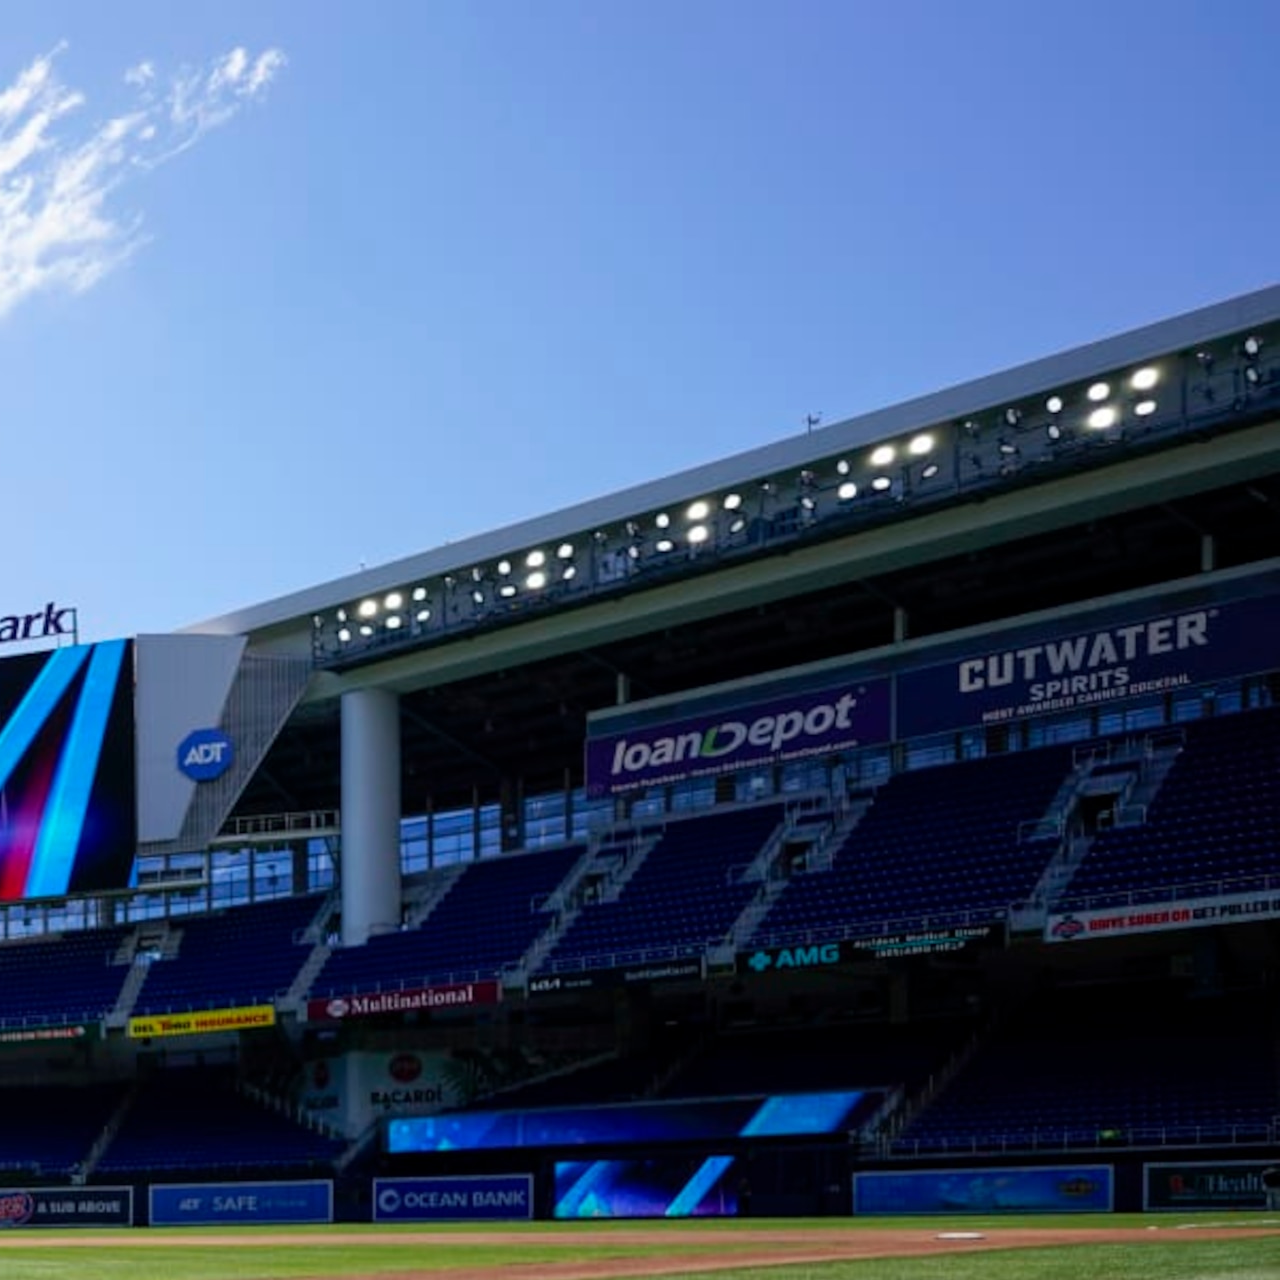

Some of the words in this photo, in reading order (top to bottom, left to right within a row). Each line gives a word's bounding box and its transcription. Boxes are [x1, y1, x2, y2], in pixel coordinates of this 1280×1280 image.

[959, 611, 1208, 693] CUTWATER
[1029, 666, 1130, 702] SPIRITS
[611, 692, 857, 775] loanDepot
[184, 741, 227, 767] ADT
[775, 943, 840, 969] AMG
[351, 984, 474, 1015] Multinational
[77, 1200, 121, 1213] ABOVE
[212, 1195, 258, 1212] SAFE
[403, 1190, 468, 1209] OCEAN
[471, 1188, 526, 1208] BANK
